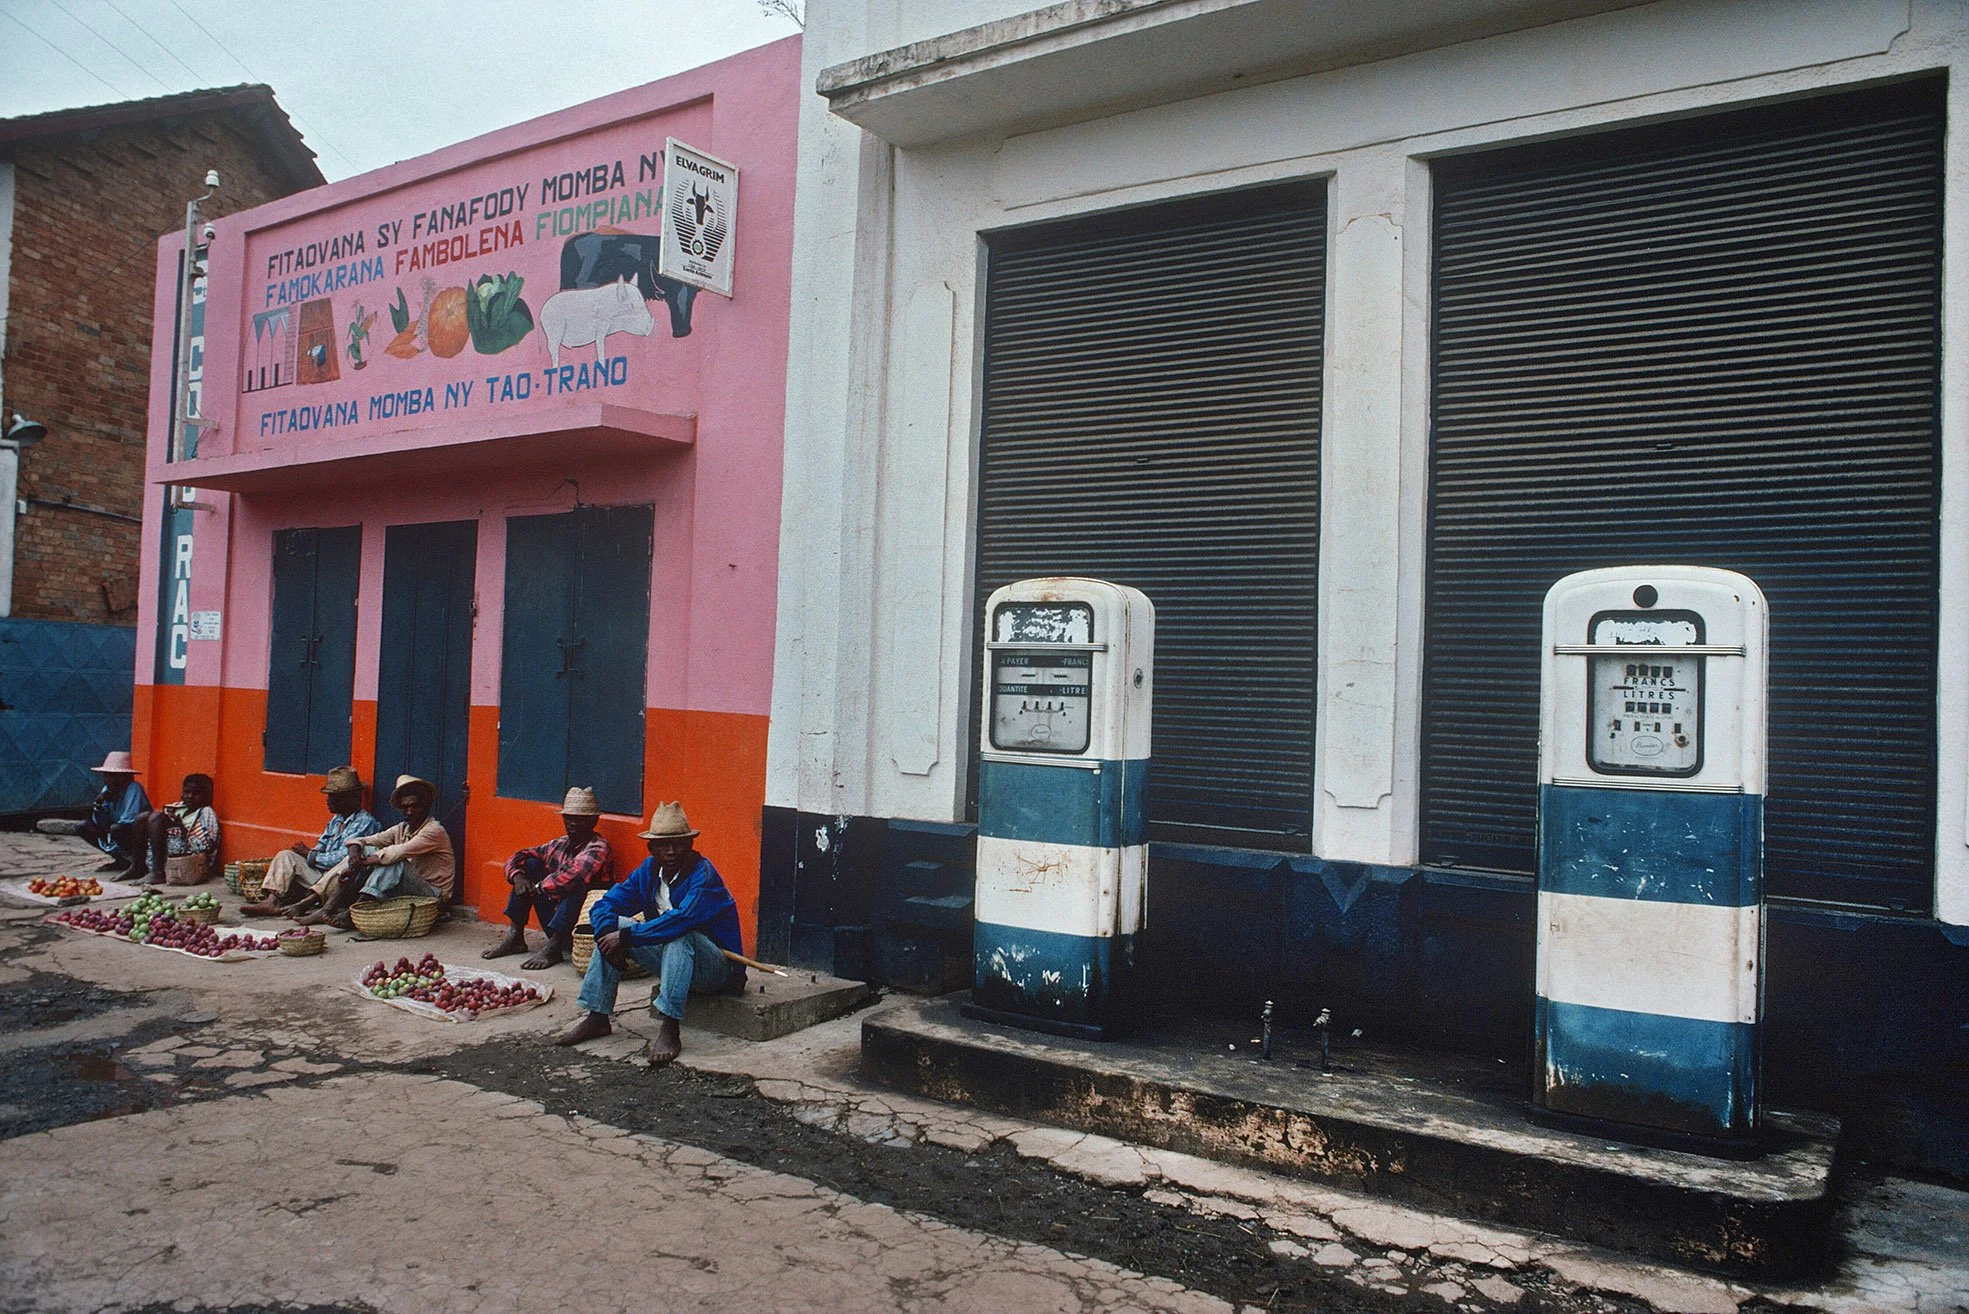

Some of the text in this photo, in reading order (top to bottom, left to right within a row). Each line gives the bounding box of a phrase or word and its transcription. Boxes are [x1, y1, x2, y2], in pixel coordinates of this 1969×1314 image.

[676, 155, 724, 184] ELVAGRIM
[267, 230, 365, 279] FITAOVANA
[377, 219, 403, 248] SY
[412, 182, 529, 239] FANAFODY
[541, 160, 625, 205] MOMBA
[265, 185, 664, 308] FAMOKARANA FAMBOLENA FIOMPIANA
[260, 400, 358, 437] FITAOVANA
[369, 387, 434, 420] MOMBA
[444, 380, 474, 409] NY
[1007, 657, 1029, 666] PAYER
[1623, 690, 1675, 700] LITRES
[1624, 678, 1675, 687] FRANCS
